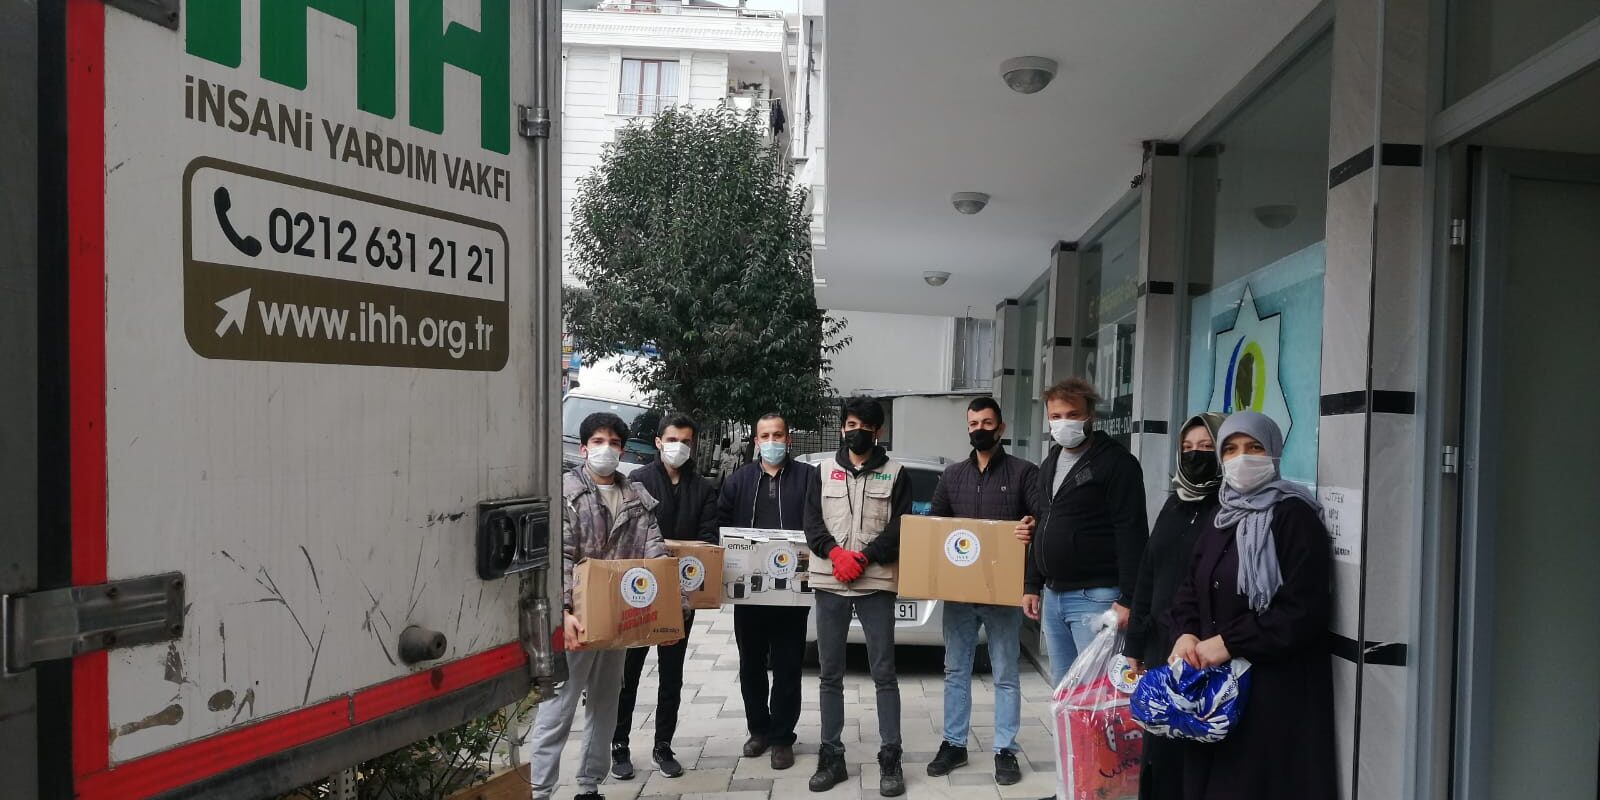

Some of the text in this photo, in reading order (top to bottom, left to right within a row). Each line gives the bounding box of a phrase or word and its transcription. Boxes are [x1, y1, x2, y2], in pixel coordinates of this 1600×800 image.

[185, 0, 511, 155] HH
[321, 118, 437, 184] YARDIM
[443, 152, 512, 202] VAKFI
[268, 207, 495, 285] 0212 631 21 21
[258, 300, 495, 359] www.ihh.org.tr
[899, 604, 913, 618] 91
